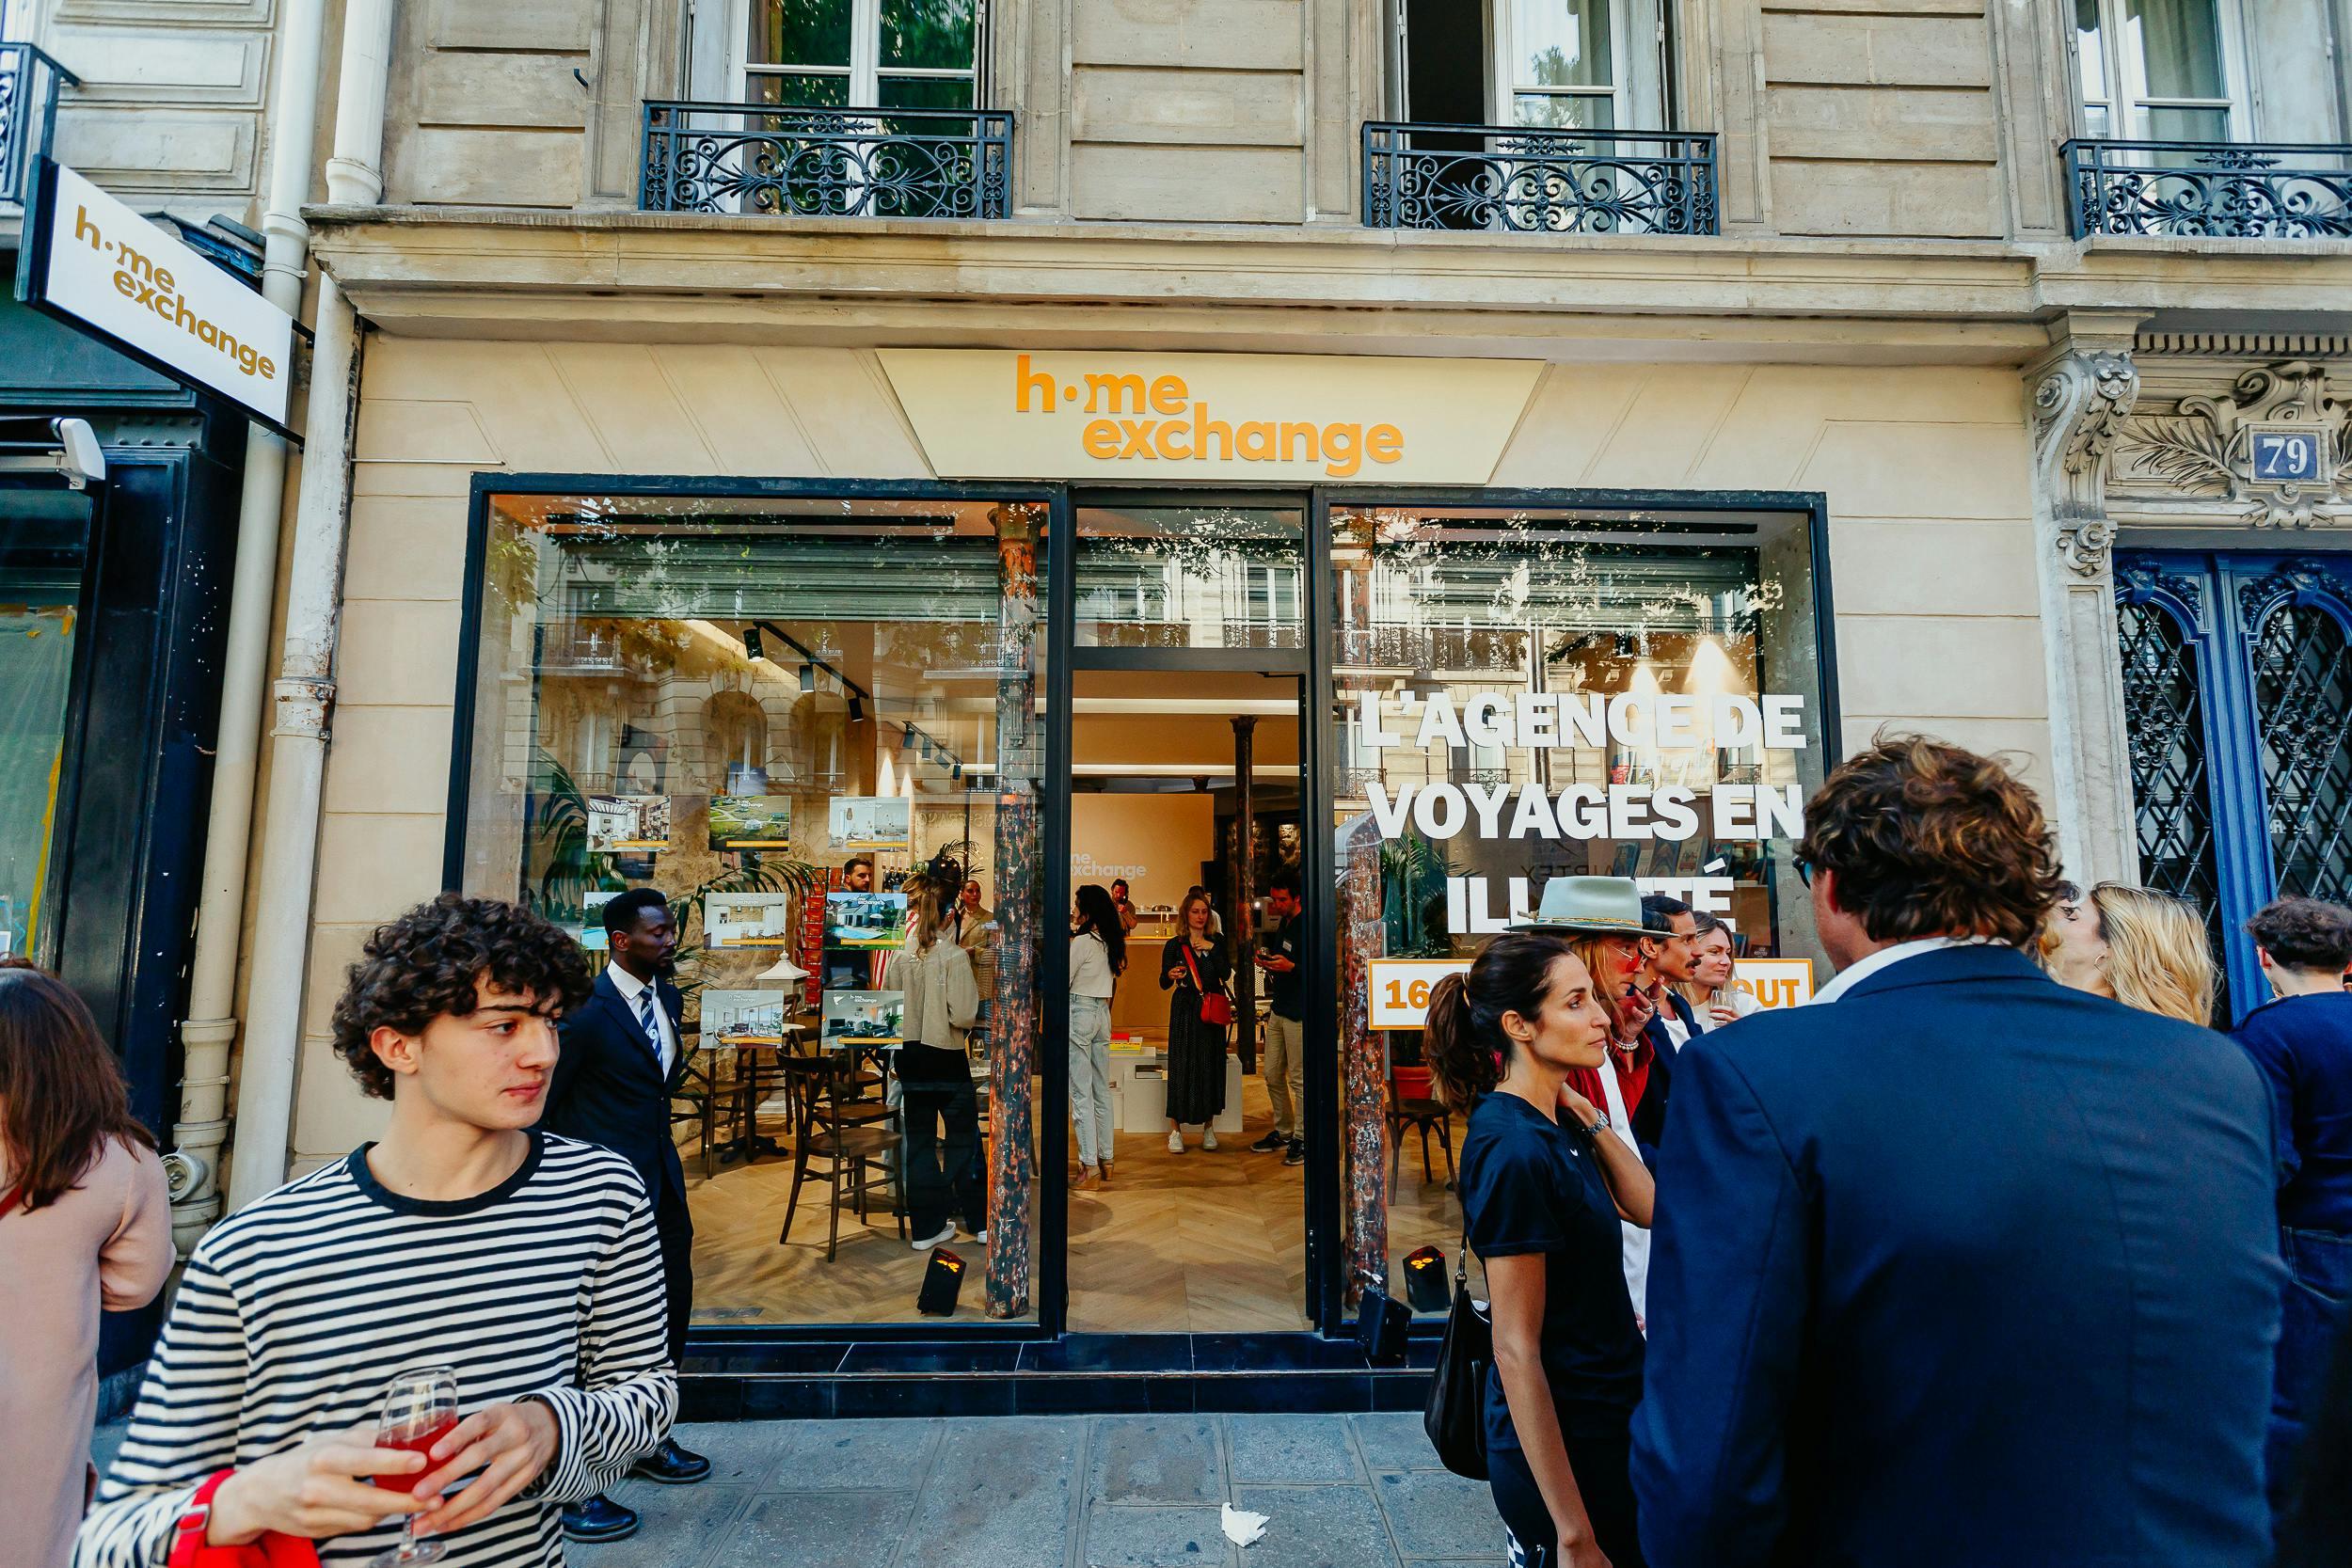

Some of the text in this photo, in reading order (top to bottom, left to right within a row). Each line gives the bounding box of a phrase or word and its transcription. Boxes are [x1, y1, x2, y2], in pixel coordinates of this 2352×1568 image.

[113, 269, 277, 380] exchange
[1082, 402, 1405, 477] exchange
[2263, 437, 2308, 474] 79
[1360, 691, 1807, 749] L'AGENCE DE
[1365, 783, 1805, 841] VOYAGES EN
[1071, 861, 1147, 880] xchange
